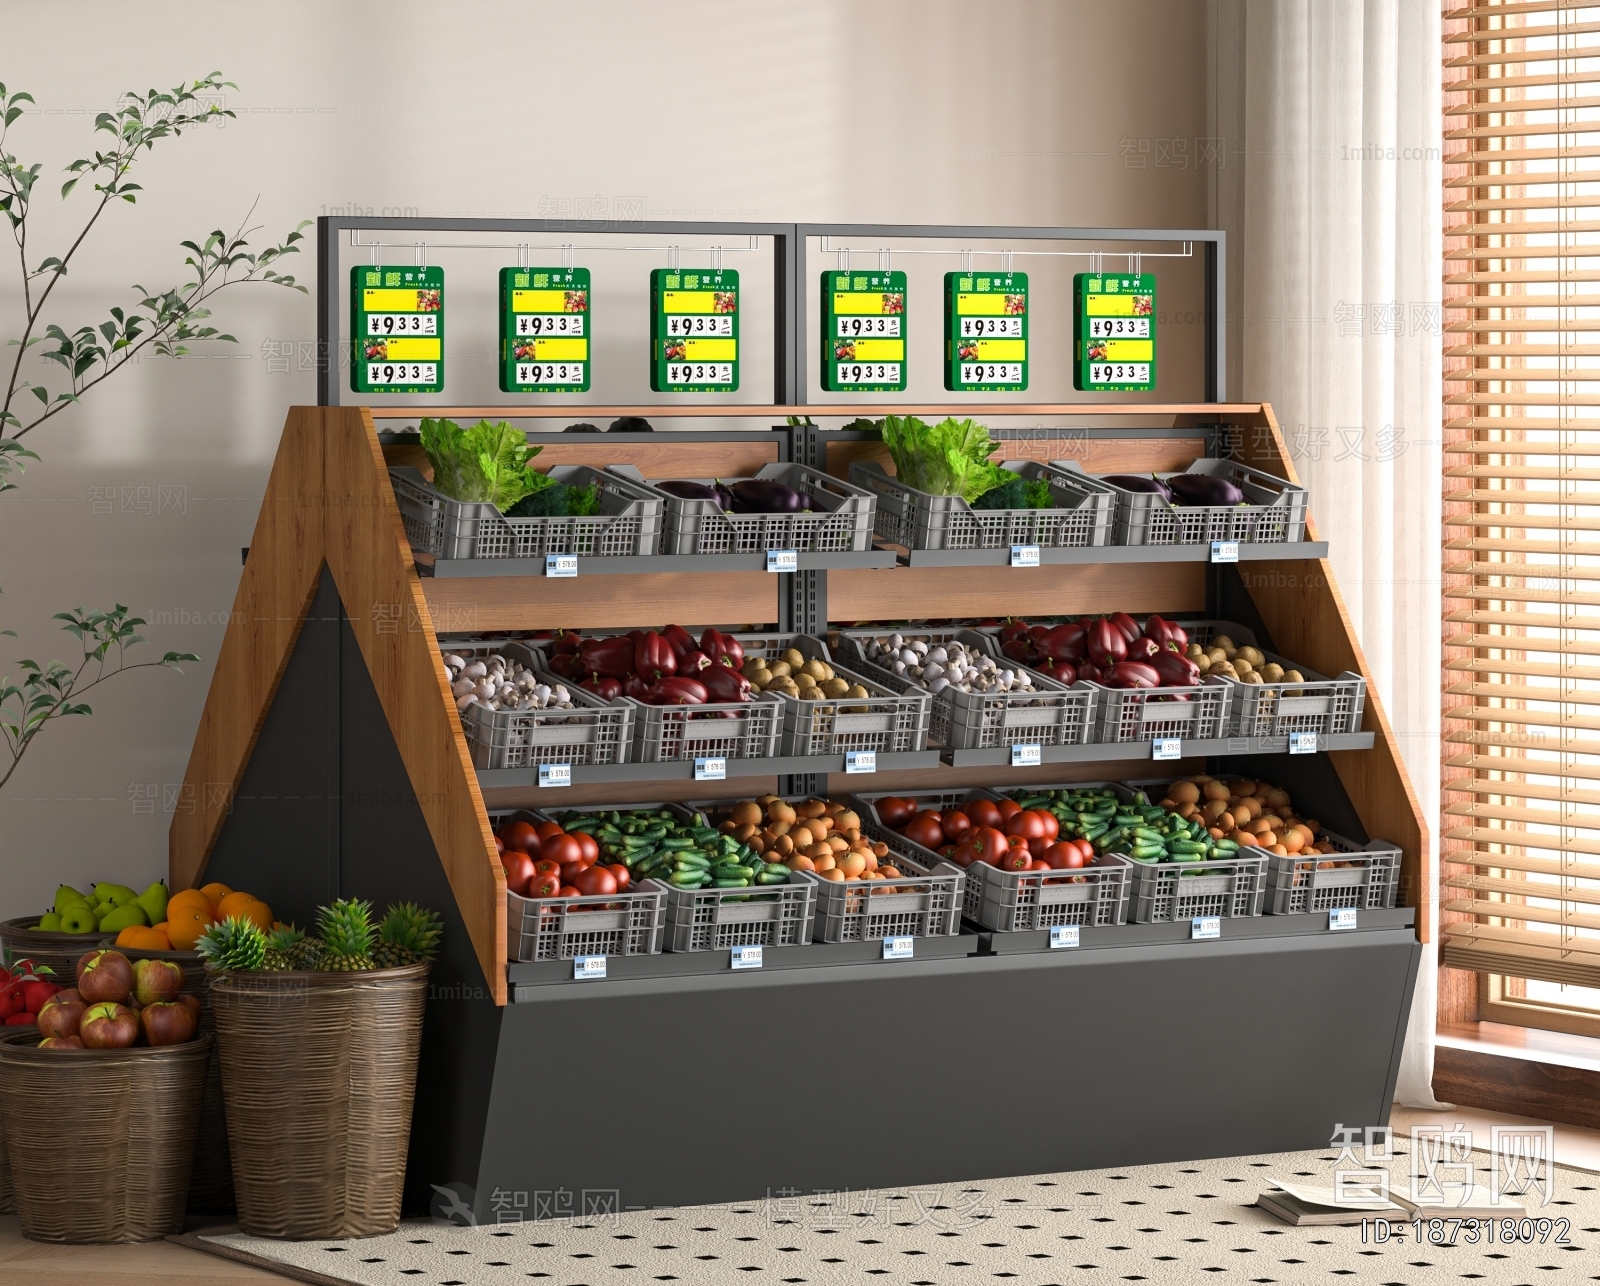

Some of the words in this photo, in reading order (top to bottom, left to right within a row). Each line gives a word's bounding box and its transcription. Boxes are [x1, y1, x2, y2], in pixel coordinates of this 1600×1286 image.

[366, 272, 401, 287] 新鲜
[405, 273, 426, 281] 营养
[515, 273, 548, 288] 新鲜
[552, 274, 573, 282] 营养
[666, 275, 698, 289] 新鲜
[702, 276, 722, 284] 营养
[836, 277, 868, 290] 新鲜
[871, 277, 891, 285] 营养
[959, 278, 990, 292] 新鲜
[1089, 279, 1119, 293] 新鲜
